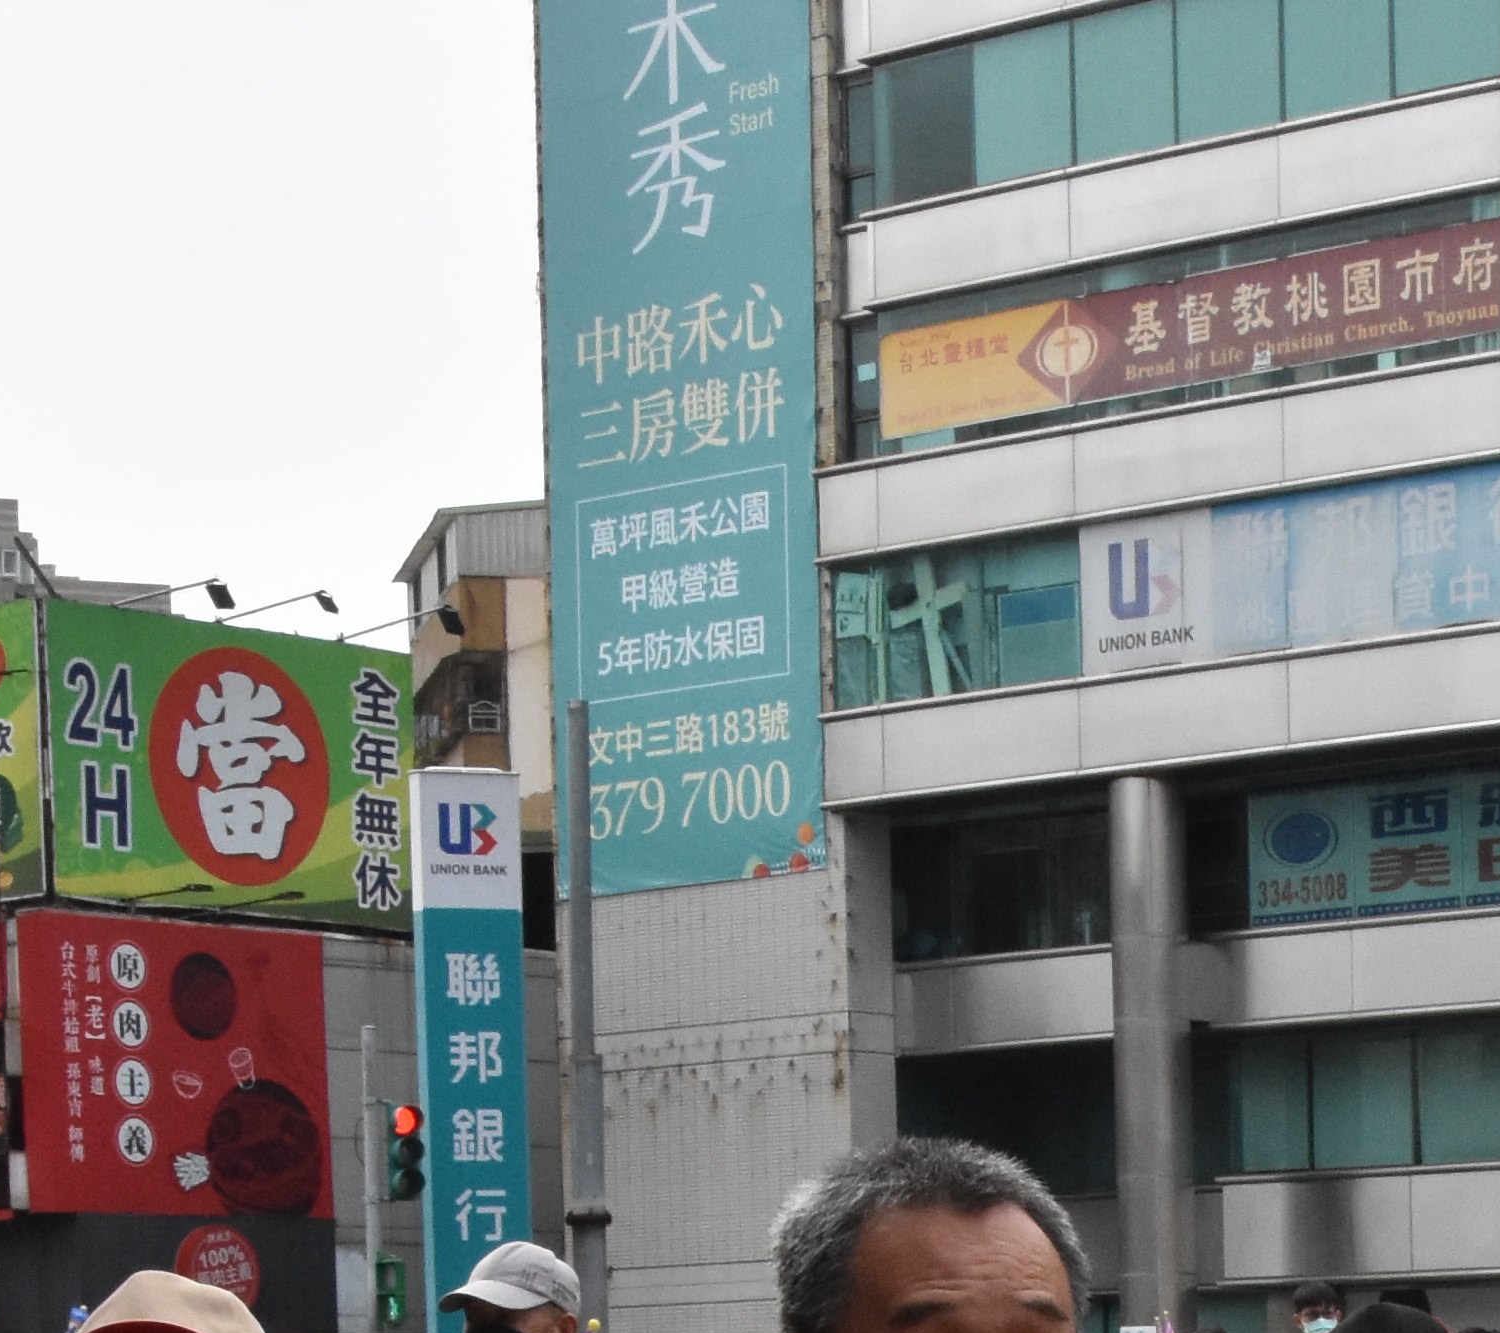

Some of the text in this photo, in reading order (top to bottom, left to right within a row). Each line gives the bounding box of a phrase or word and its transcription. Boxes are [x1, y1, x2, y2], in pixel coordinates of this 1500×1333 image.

[728, 75, 779, 103] Fresh
[730, 107, 774, 136] Start
[576, 283, 784, 385] 中路禾心
[1125, 359, 1175, 382] Bread
[1184, 351, 1202, 371] of
[1210, 345, 1245, 369] Life
[1253, 325, 1334, 358] Christian
[1423, 300, 1499, 332] Taoyuan
[577, 369, 786, 470] 三房雙併
[589, 491, 770, 560] 萬坪風禾公園
[621, 559, 740, 613] 甲級營造
[598, 616, 765, 677] 5年防水保固
[1098, 624, 1194, 655] UNION BANK
[62, 654, 137, 750] 24
[588, 701, 791, 768] 文中三路183號
[176, 672, 305, 861] 當
[350, 667, 402, 911] 全年無休
[590, 759, 791, 841] 379 7000
[82, 761, 133, 851] H
[430, 863, 508, 876] UNION BANK
[1258, 873, 1348, 908] 334-5008
[116, 952, 148, 1156] 原肉主義
[446, 952, 507, 1241] 聯邦銀行
[199, 1245, 245, 1268] 100%
